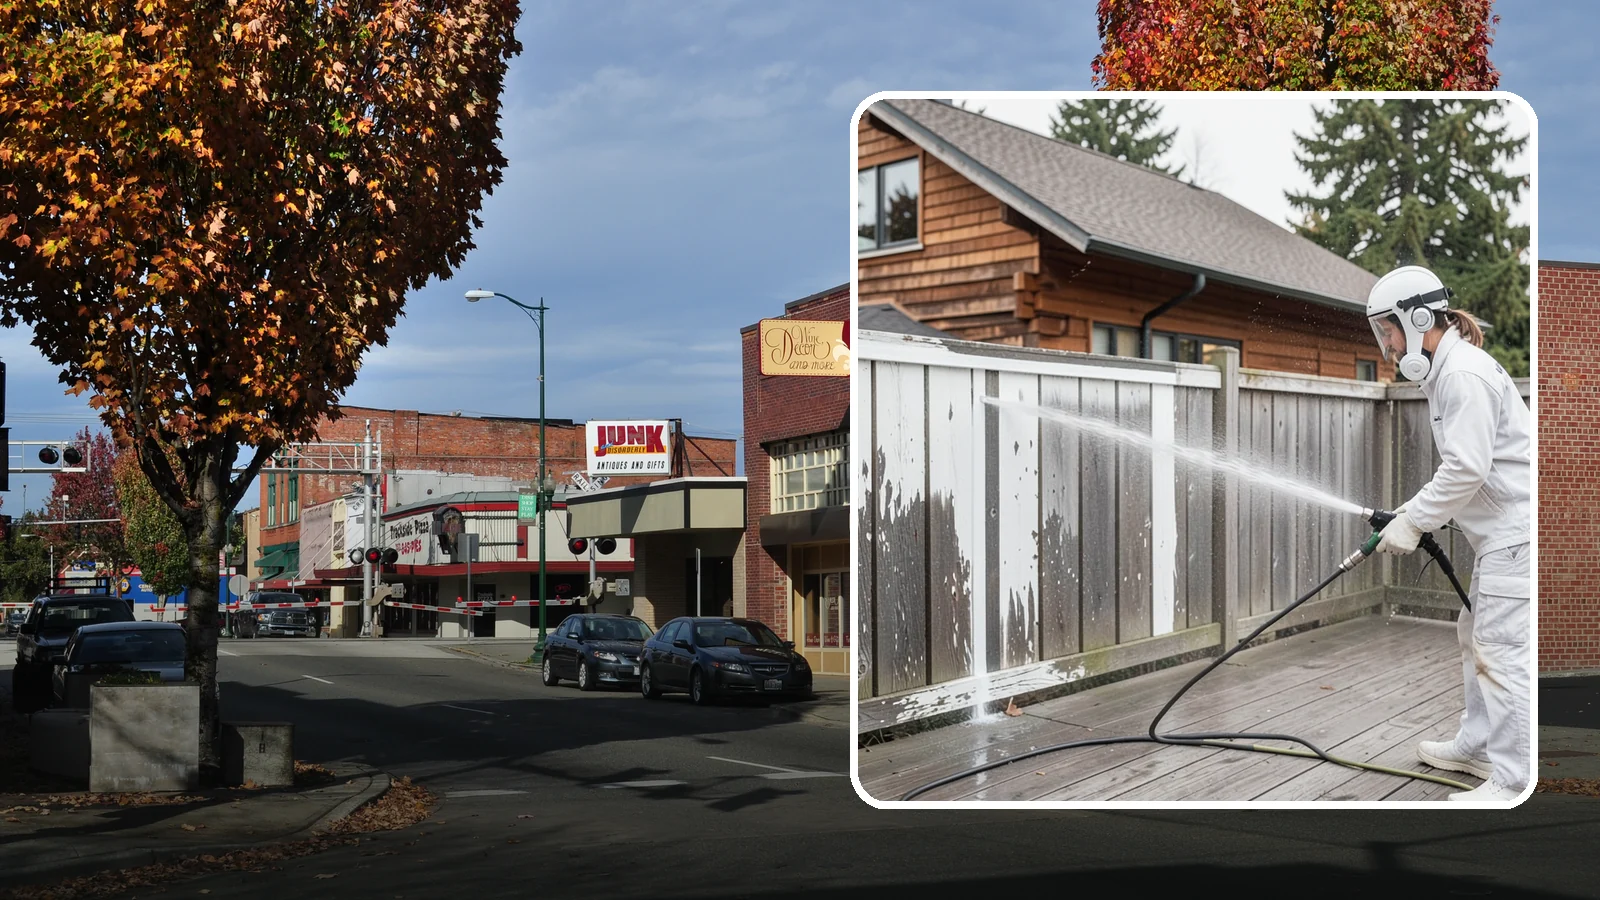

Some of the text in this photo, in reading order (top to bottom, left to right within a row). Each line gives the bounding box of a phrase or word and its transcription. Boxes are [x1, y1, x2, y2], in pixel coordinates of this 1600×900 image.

[764, 327, 831, 365] Decor
[595, 425, 665, 457] JUNK
[607, 446, 646, 454] DISORDERLY
[597, 460, 665, 470] ANTIQUES AND GIFTS
[390, 519, 429, 540] Trackside Pizza
